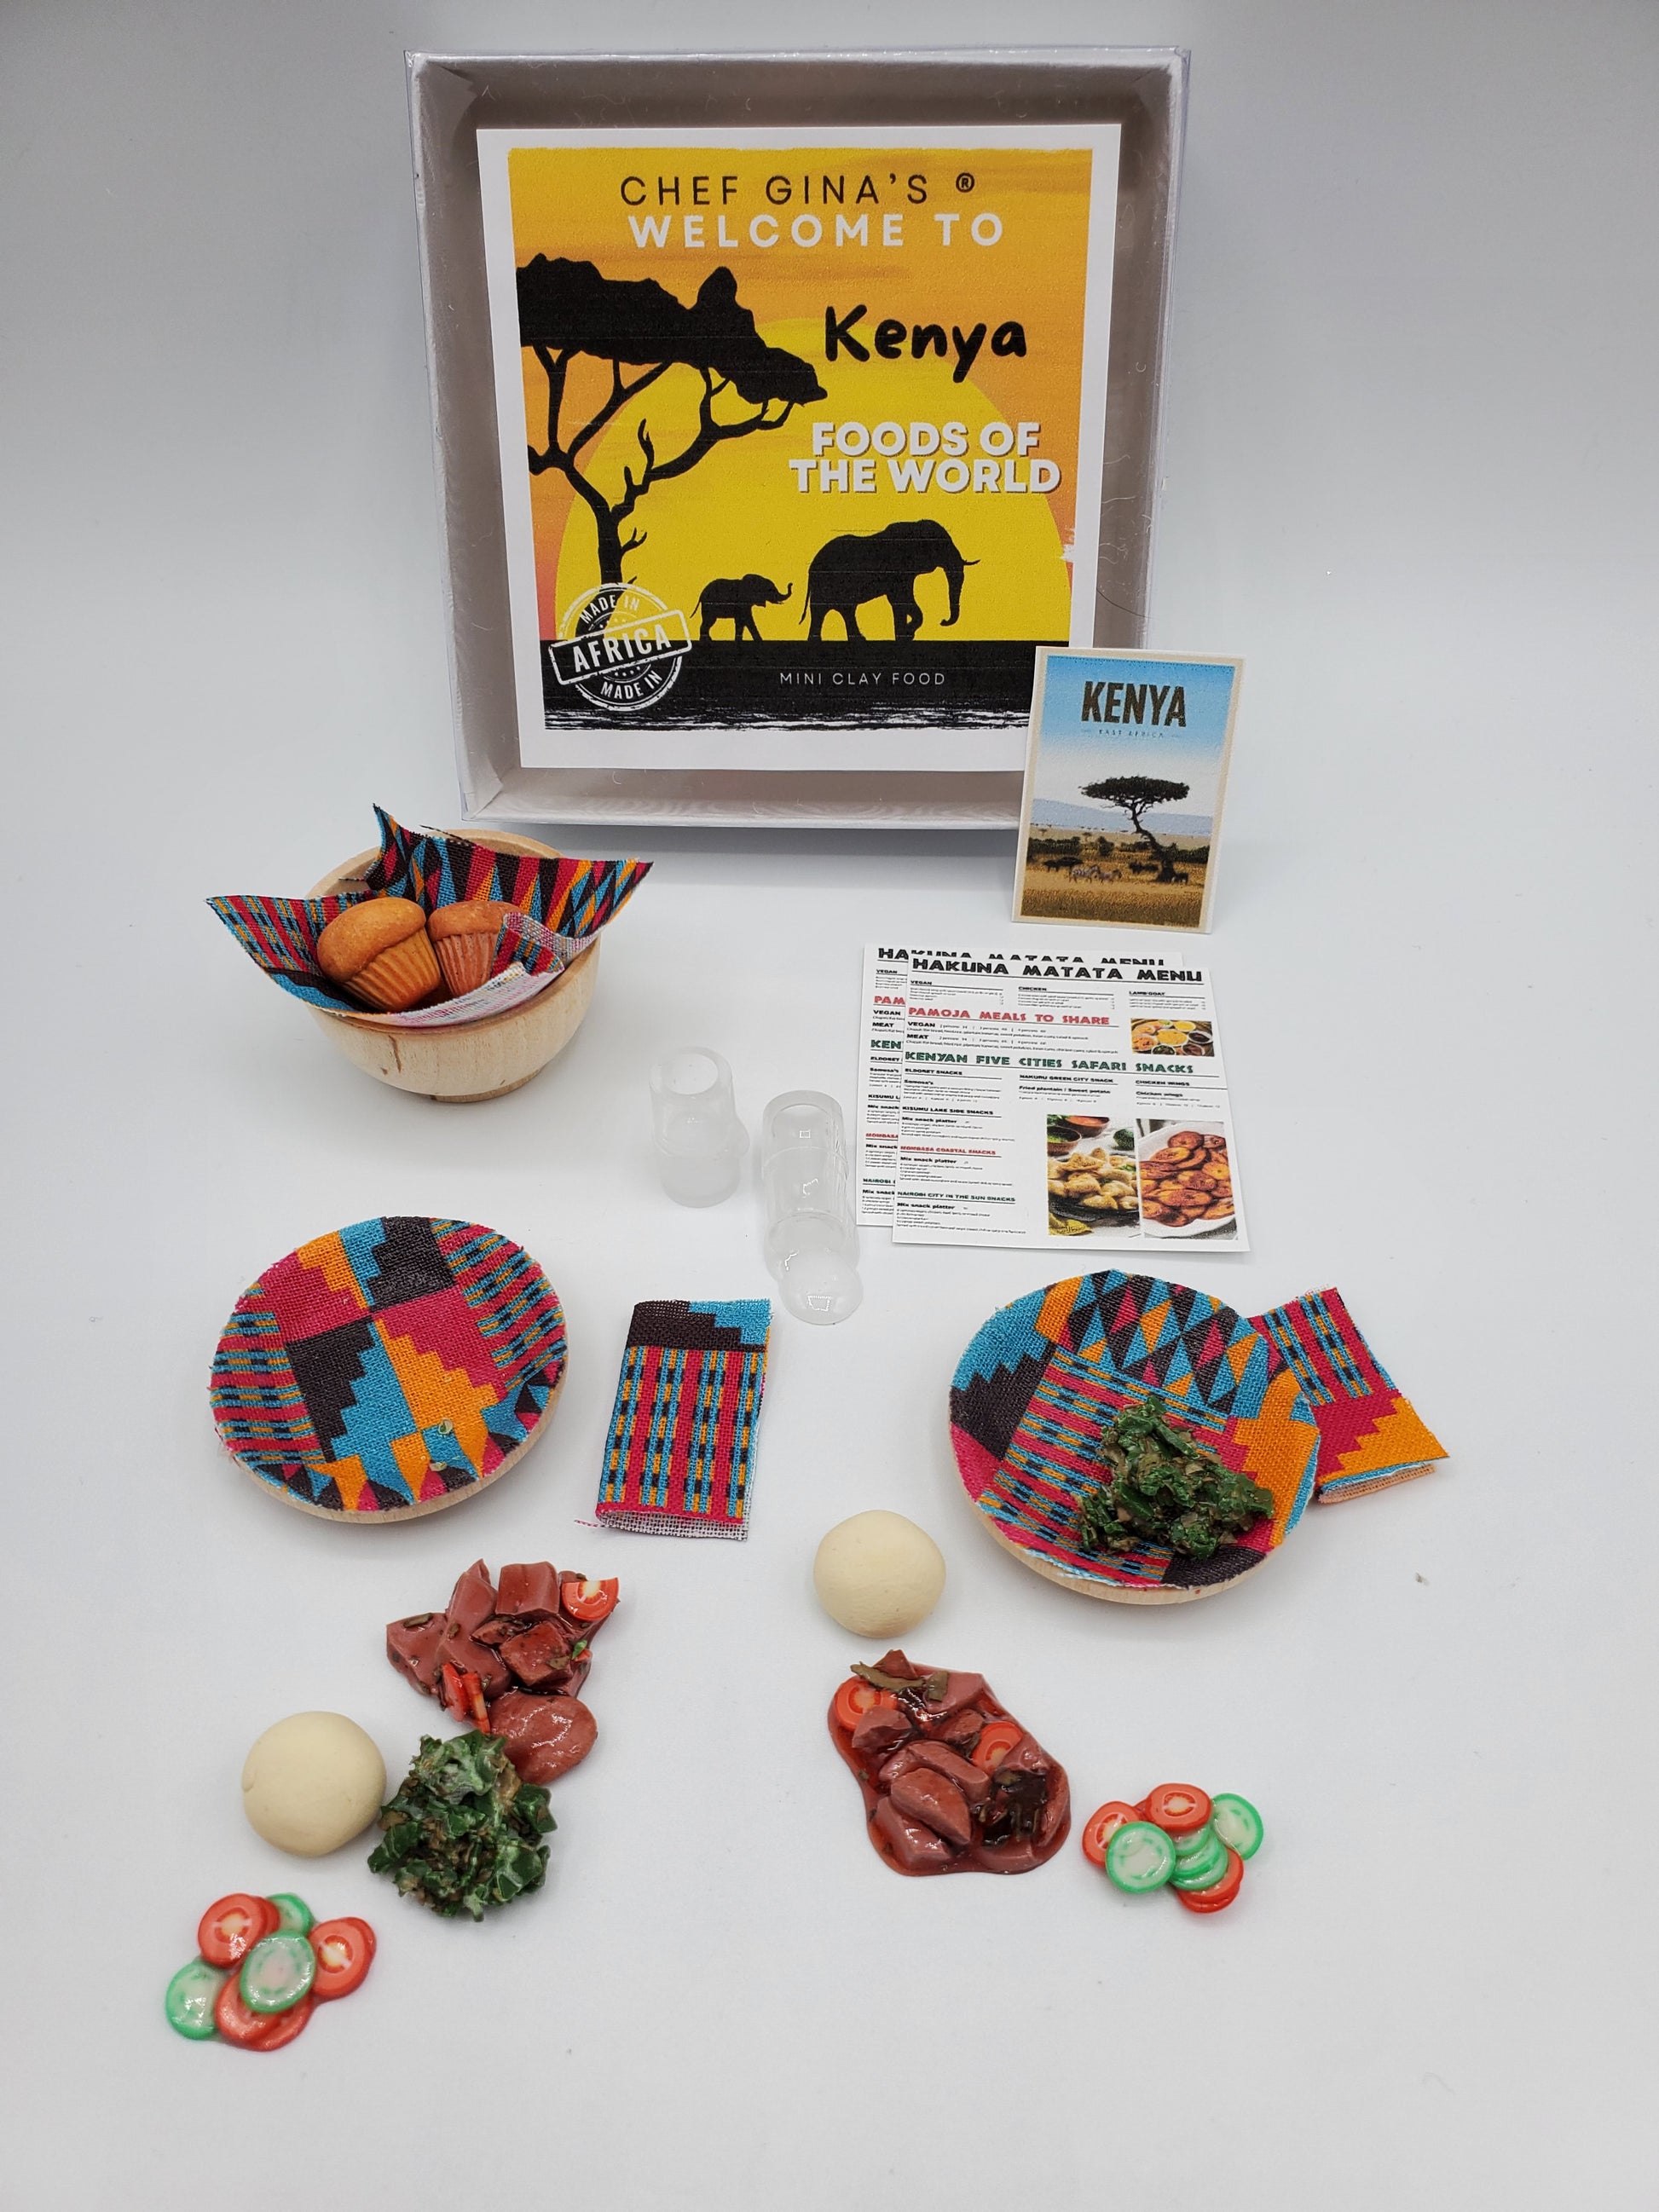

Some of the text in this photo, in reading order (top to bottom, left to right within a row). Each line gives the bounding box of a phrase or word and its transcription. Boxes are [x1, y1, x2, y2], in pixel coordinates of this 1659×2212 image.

[621, 176, 737, 205] CHEF
[766, 173, 928, 205] GINA'S
[627, 212, 1003, 248] WELCOME TO
[825, 304, 1026, 383] Kenya
[812, 421, 1041, 457] FOODS OF
[789, 459, 1062, 494] THE WORLD
[580, 595, 640, 623] MADE IN
[573, 624, 672, 673] AFRICA
[600, 670, 662, 700] MADE IN
[780, 673, 945, 685] MINI CLAY FOOD
[1081, 681, 1187, 727] KENYA
[912, 958, 1202, 981] HAKUNA MATATA MENU
[908, 1008, 1110, 1025] PAMOJA MEALS TO SHARE
[905, 1051, 1194, 1073] KENYAN FIVE CITIES SAFARI SNACKS
